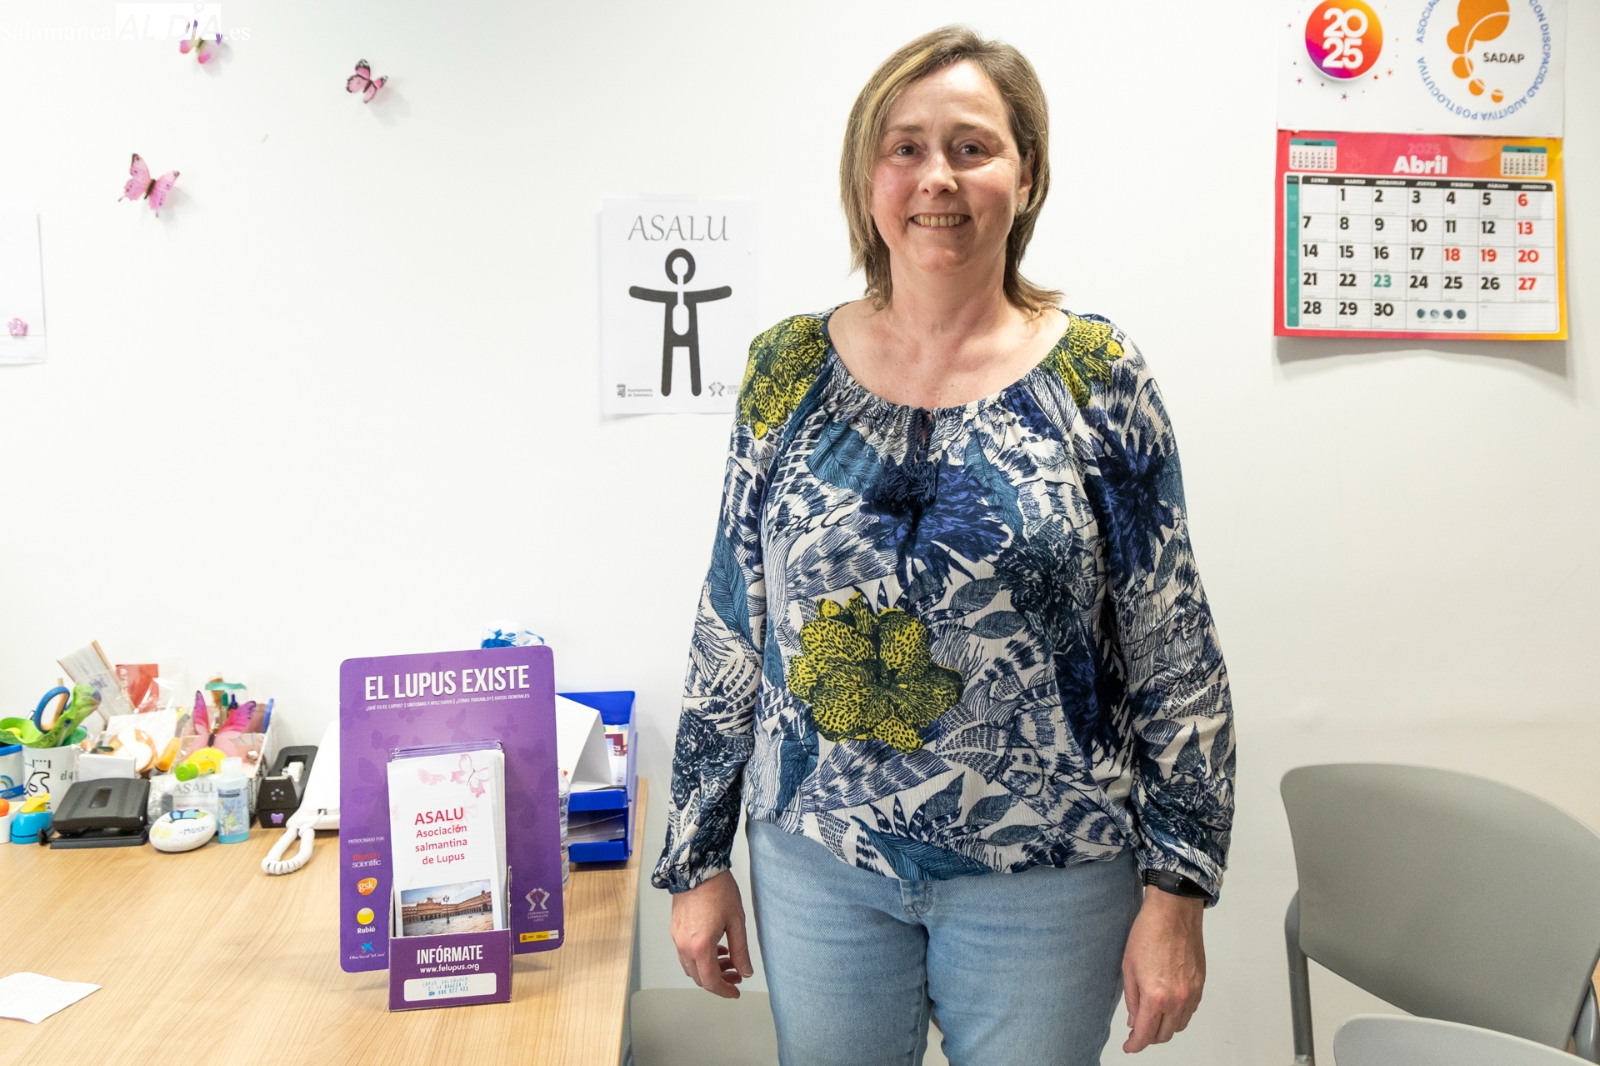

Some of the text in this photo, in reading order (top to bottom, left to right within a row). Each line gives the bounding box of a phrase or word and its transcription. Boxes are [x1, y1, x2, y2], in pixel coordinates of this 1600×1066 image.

[1323, 7, 1368, 38] 20
[1322, 36, 1364, 69] 25
[1483, 52, 1525, 63] SADAP
[1417, 56, 1479, 120] POSTLOCUTIVA
[1480, 95, 1527, 120] AUDITIVA
[1393, 154, 1448, 174] Abril
[1340, 188, 1346, 201] 1
[1374, 189, 1383, 203] 2
[1412, 190, 1421, 204] 3
[1446, 191, 1456, 204] 4
[1482, 192, 1492, 205] 5
[1518, 193, 1528, 207] 6
[627, 214, 730, 242] ASALU
[1303, 216, 1311, 228] 7
[1340, 217, 1349, 230] 8
[1374, 217, 1384, 231] 9
[1411, 219, 1427, 232] 10
[1445, 220, 1456, 233] 11
[1481, 221, 1496, 234] 12
[1518, 222, 1533, 235] 13
[1303, 244, 1318, 257] 14
[1339, 245, 1354, 258] 15
[1374, 246, 1389, 259] 16
[1410, 247, 1424, 260] 17
[1445, 248, 1460, 261] 18
[1481, 249, 1497, 262] 19
[1518, 249, 1539, 263] 20
[1303, 272, 1317, 286] 21
[1339, 273, 1356, 287] 22
[1373, 274, 1392, 288] 23
[1410, 275, 1428, 289] 24
[1444, 276, 1462, 289] 25
[1481, 277, 1500, 290] 26
[1518, 277, 1536, 290] 27
[1303, 301, 1322, 314] 28
[1339, 302, 1358, 315] 29
[1374, 302, 1394, 316] 30
[365, 665, 530, 701] EL LUPUS EXISTE
[414, 807, 464, 825] ASALU
[416, 824, 467, 838] Asociación
[415, 838, 468, 852] salmantina
[422, 853, 465, 865] de Lupus
[358, 881, 374, 892] gsk
[357, 926, 376, 934] Rubió
[417, 945, 483, 965] INFÓRMATE
[420, 963, 480, 973] www.felupus.org
